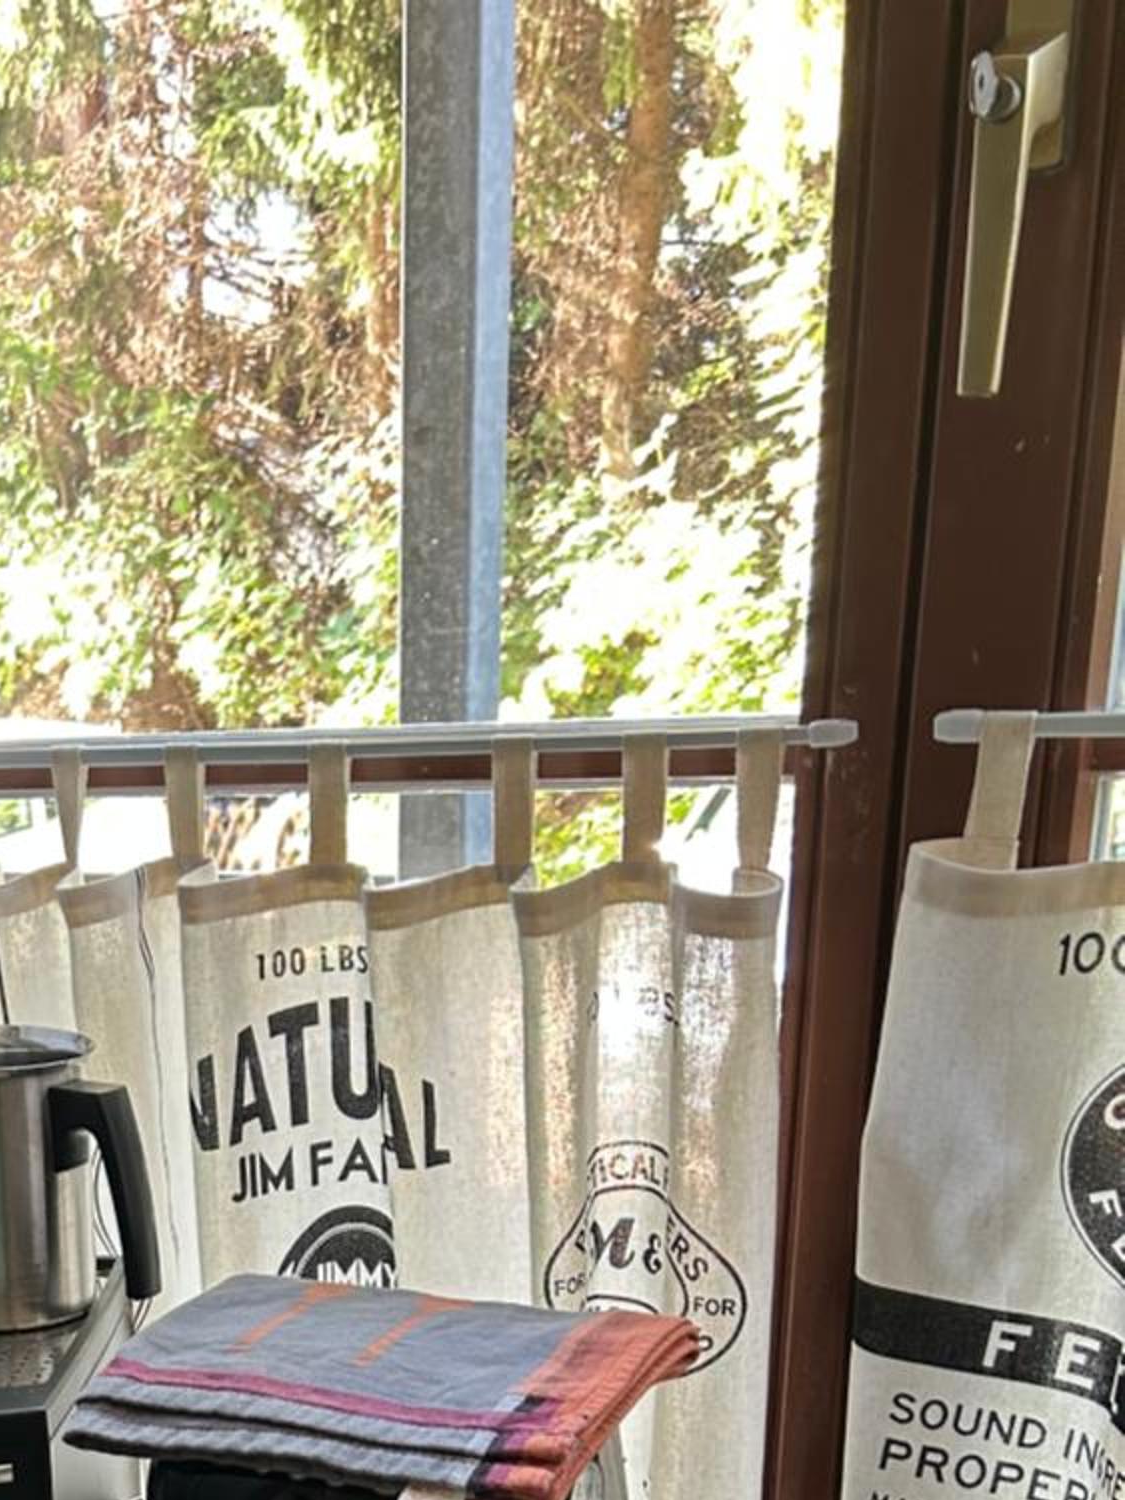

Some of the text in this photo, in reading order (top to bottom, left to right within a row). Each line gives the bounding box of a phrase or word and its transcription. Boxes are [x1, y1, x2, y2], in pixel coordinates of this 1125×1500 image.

[257, 946, 369, 980] 100 LBS
[232, 1147, 295, 1202] JIM
[692, 1297, 736, 1317] FOR
[889, 1393, 1047, 1450] SOUND
